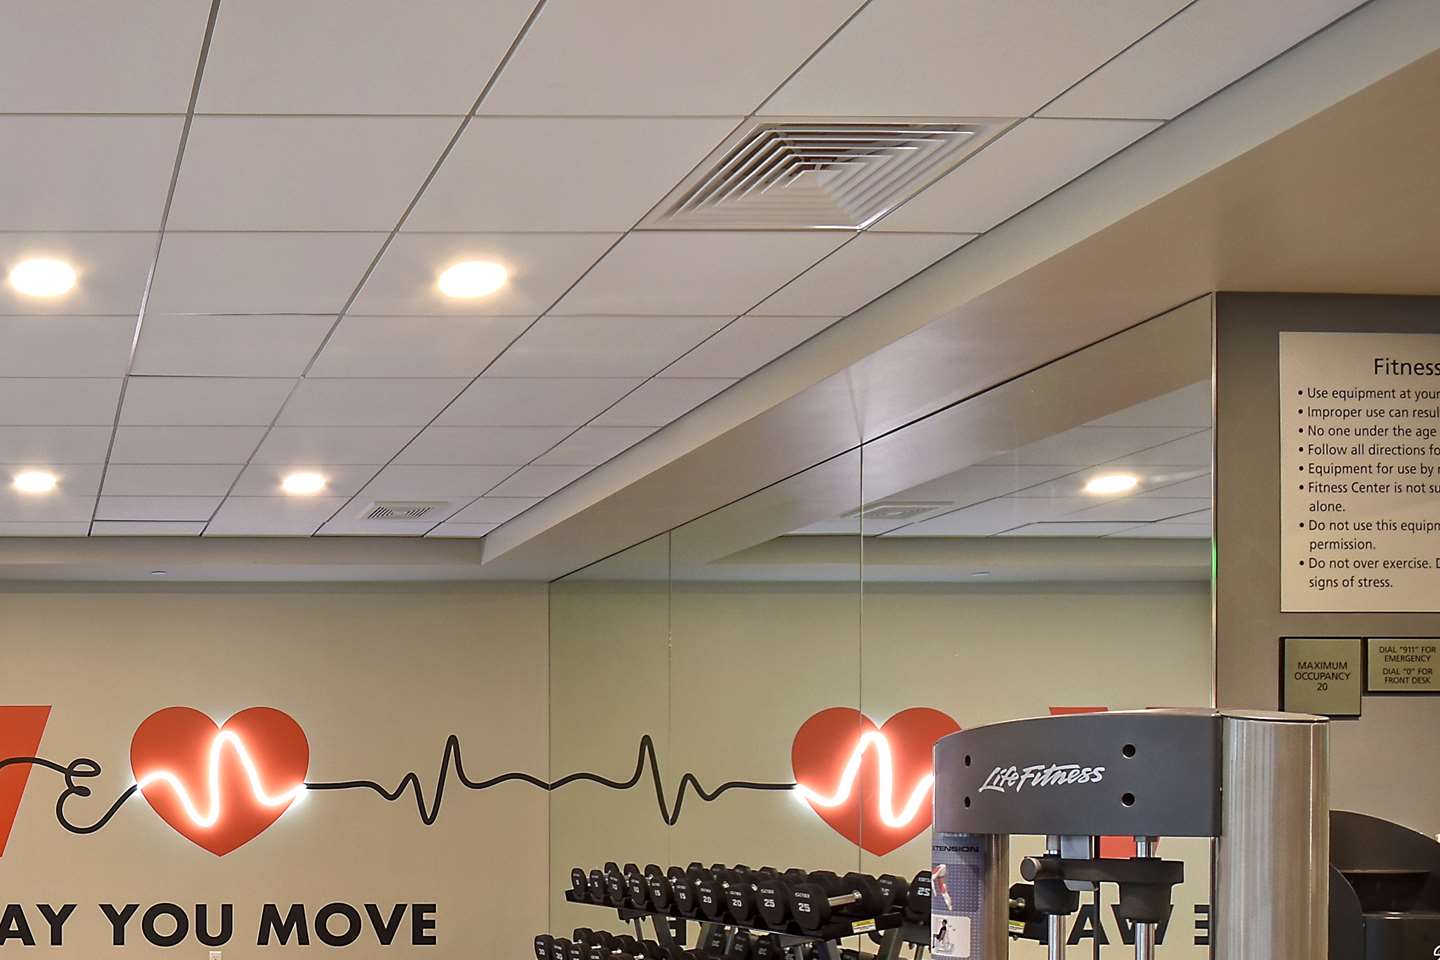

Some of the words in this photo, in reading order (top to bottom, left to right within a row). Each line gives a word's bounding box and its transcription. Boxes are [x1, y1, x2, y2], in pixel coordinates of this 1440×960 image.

[1374, 358, 1440, 376] Fitness
[1307, 387, 1328, 399] Use
[1332, 388, 1396, 401] equipment
[1400, 390, 1411, 399] at
[1415, 391, 1440, 402] your
[1307, 406, 1362, 420] Improper
[1366, 409, 1385, 418] use
[1389, 409, 1409, 418] can
[1308, 425, 1325, 437] No
[1328, 428, 1350, 437] one
[1354, 426, 1389, 437] under
[1393, 426, 1412, 437] the
[1416, 428, 1437, 440] age
[1308, 444, 1347, 455] Follow
[1351, 444, 1364, 455] all
[1368, 444, 1426, 456] directions
[1308, 462, 1373, 476] Equipment
[1377, 462, 1393, 474] for
[1397, 465, 1416, 474] use
[1420, 463, 1434, 477] by
[1308, 482, 1348, 493] Fitness
[1351, 482, 1390, 493] Center
[1394, 481, 1402, 493] is
[1406, 484, 1427, 493] not
[1309, 500, 1346, 512] alone.
[1308, 520, 1325, 531] Do
[1329, 521, 1349, 531] not
[1353, 522, 1373, 531] use
[1376, 520, 1398, 531] this
[1309, 538, 1376, 552] permission.
[1308, 558, 1325, 568] Do
[1329, 559, 1349, 568] not
[1353, 560, 1379, 569] over
[1382, 557, 1432, 569] exercise.
[1309, 576, 1339, 590] signs
[1342, 576, 1355, 588] of
[1358, 577, 1393, 588] stress.
[1298, 662, 1348, 670] MAXIMUM
[1294, 672, 1351, 680] OCCUPANCY
[1317, 683, 1328, 691] 20
[763, 898, 776, 908] 25
[798, 902, 811, 912] 25
[98, 902, 233, 947] YOU
[256, 902, 437, 947] MOVE
